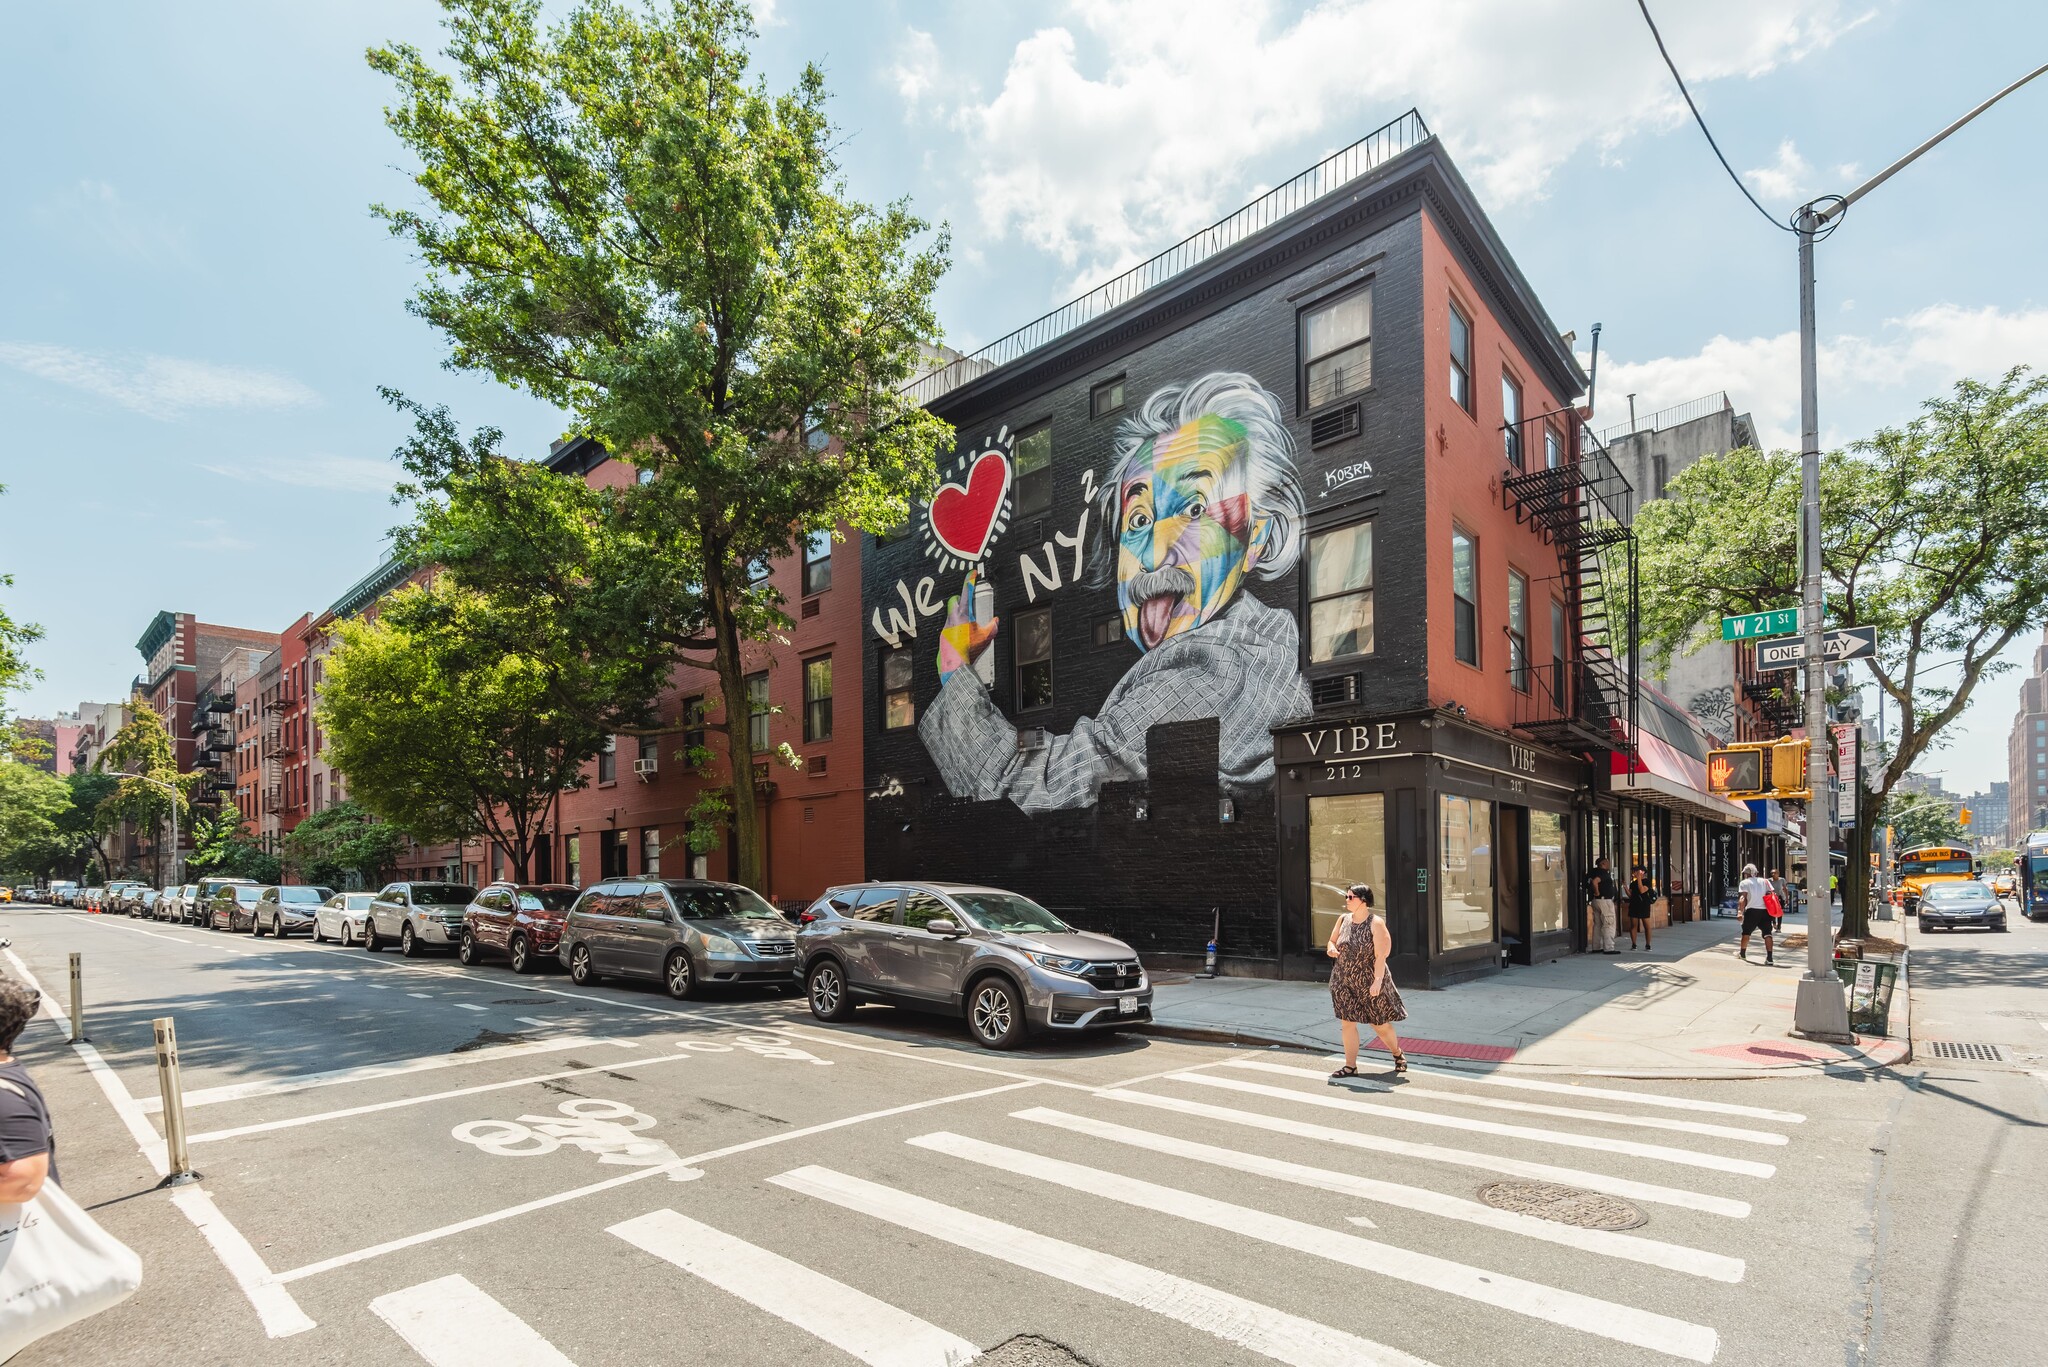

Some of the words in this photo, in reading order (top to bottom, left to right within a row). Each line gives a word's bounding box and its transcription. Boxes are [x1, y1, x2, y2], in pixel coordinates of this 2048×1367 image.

[1325, 460, 1373, 487] KOBRA
[871, 576, 944, 649] We
[1733, 619, 1746, 637] W
[1754, 616, 1770, 634] 21
[1778, 613, 1789, 625] St
[1769, 646, 1800, 660] ONE
[1302, 722, 1399, 756] VIBE
[1510, 744, 1536, 773] VIBE
[1326, 765, 1361, 781] 212
[1510, 779, 1522, 792] 212
